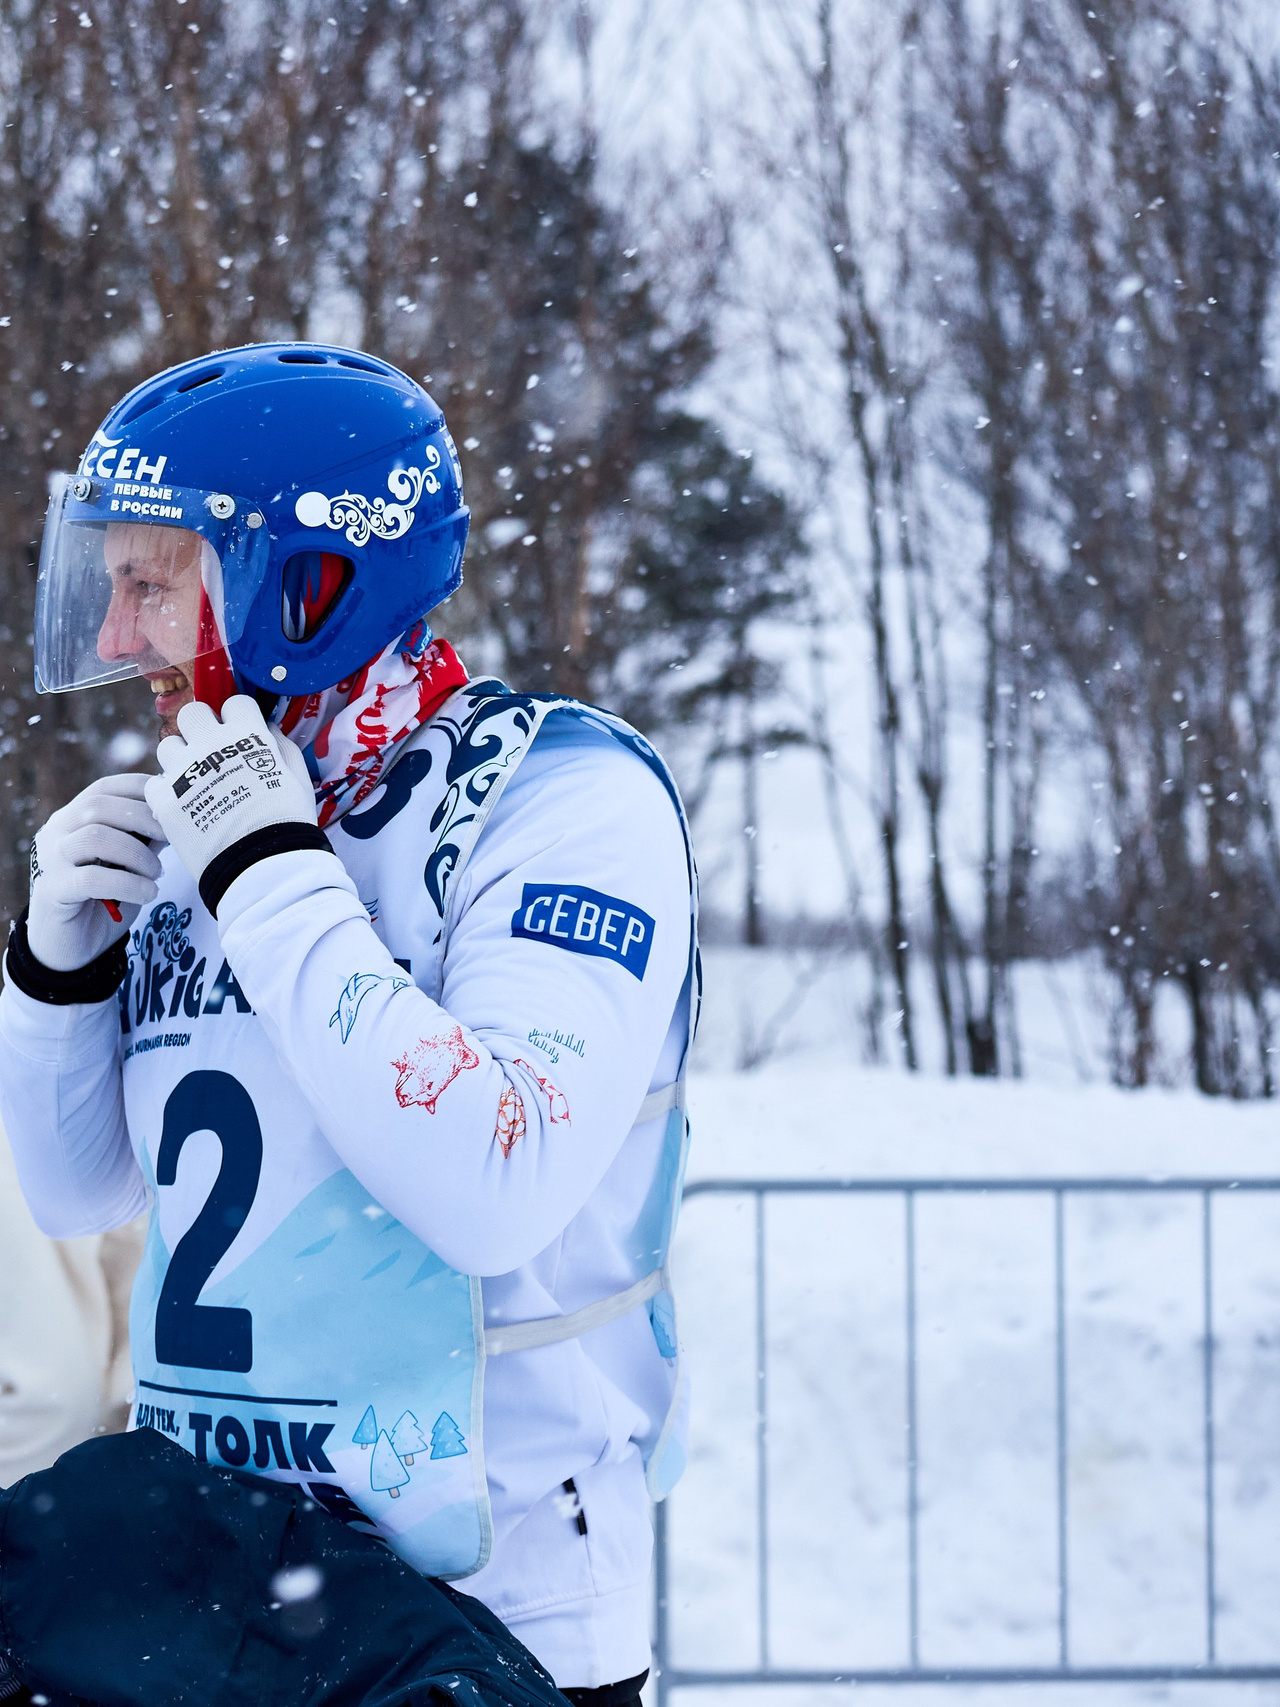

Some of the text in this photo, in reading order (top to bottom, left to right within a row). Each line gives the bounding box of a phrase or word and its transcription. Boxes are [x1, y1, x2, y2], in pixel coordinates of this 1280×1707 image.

[82, 448, 168, 485] ССЕН
[110, 499, 183, 520] В РОССИИ
[113, 482, 173, 501] ПЕРВЫЕ
[181, 763, 244, 812] Перчатки защитные
[194, 784, 249, 828] Размер 9/L
[220, 791, 252, 815] 019/2011
[189, 794, 215, 819] Atlas
[523, 893, 646, 957] СЕВЕР
[164, 1032, 192, 1047] REGION
[154, 1069, 264, 1374] 2
[188, 1411, 337, 1474] ТОЛК
